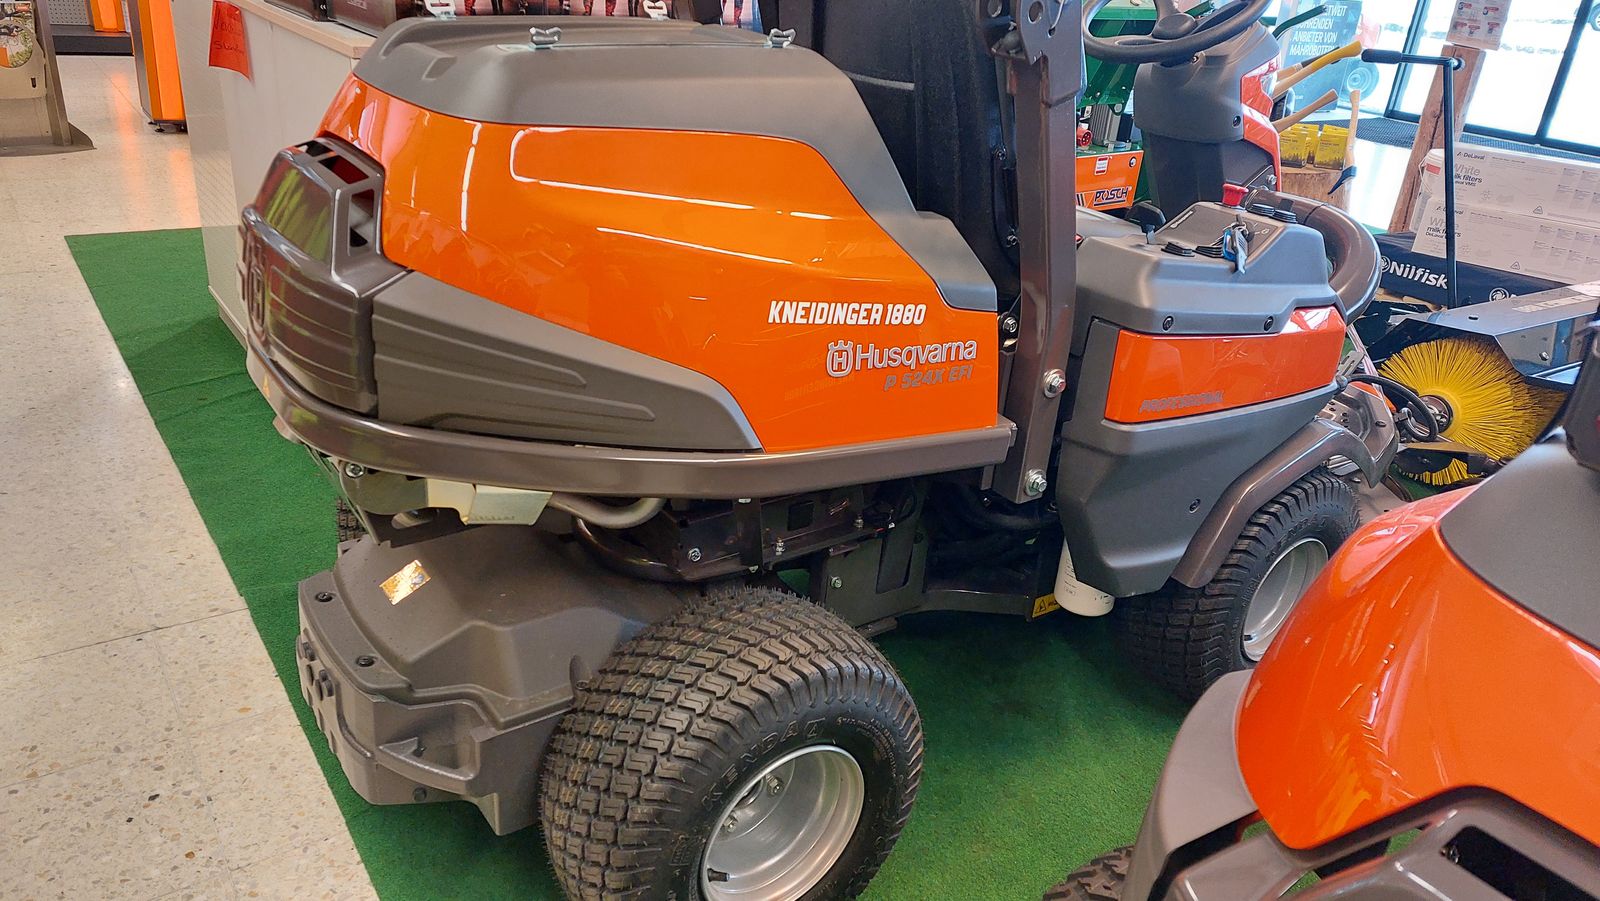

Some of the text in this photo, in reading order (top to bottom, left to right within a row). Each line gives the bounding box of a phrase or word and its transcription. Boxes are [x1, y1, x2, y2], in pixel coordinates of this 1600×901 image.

[1292, 31, 1338, 43] ANBIETER VON
[1462, 174, 1483, 183] filters
[1094, 187, 1129, 202] POSCH
[1390, 261, 1448, 289] Nilfisk
[768, 301, 926, 325] KNEIDINGER 1880
[855, 340, 977, 371] Husqvarna
[884, 365, 973, 392] P 524X EFI
